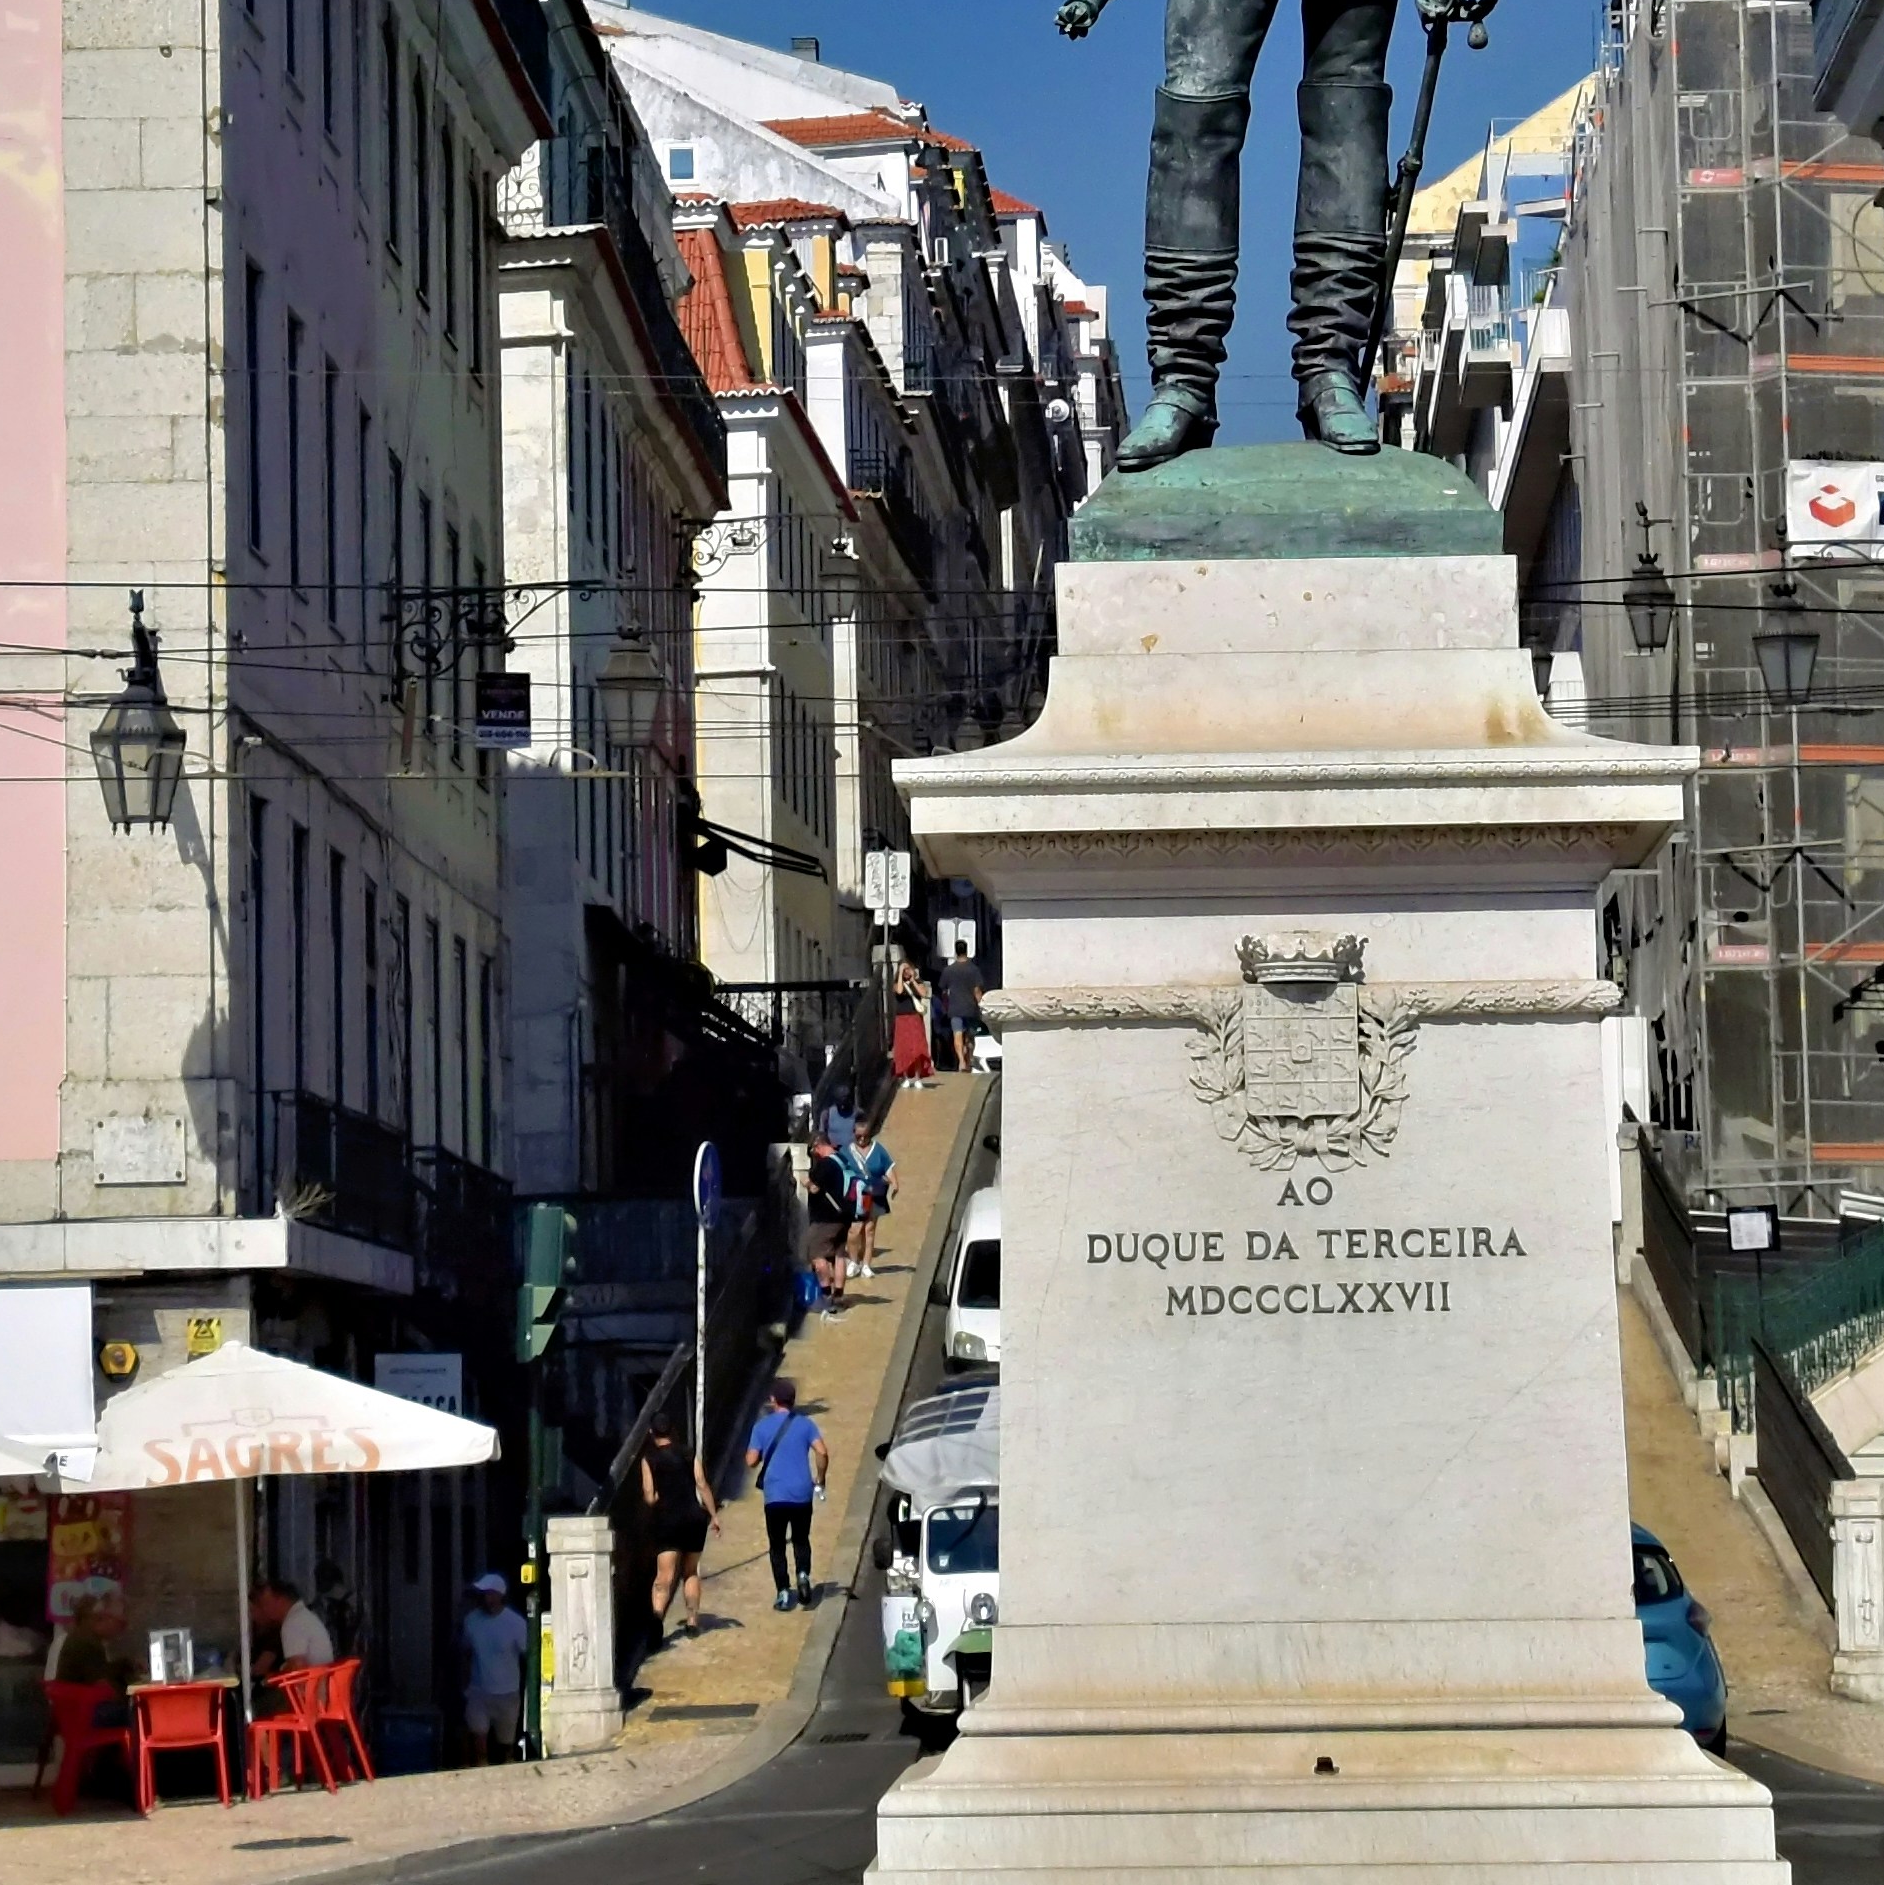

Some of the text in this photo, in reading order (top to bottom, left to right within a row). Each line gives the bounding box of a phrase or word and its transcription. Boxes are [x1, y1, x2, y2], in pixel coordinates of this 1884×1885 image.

[1276, 1176, 1333, 1206] AO
[1087, 1226, 1527, 1269] DUQUE DA TERCEIRA
[1165, 1281, 1451, 1316] MDCCCLXXVII
[143, 1426, 382, 1487] SAGRES
